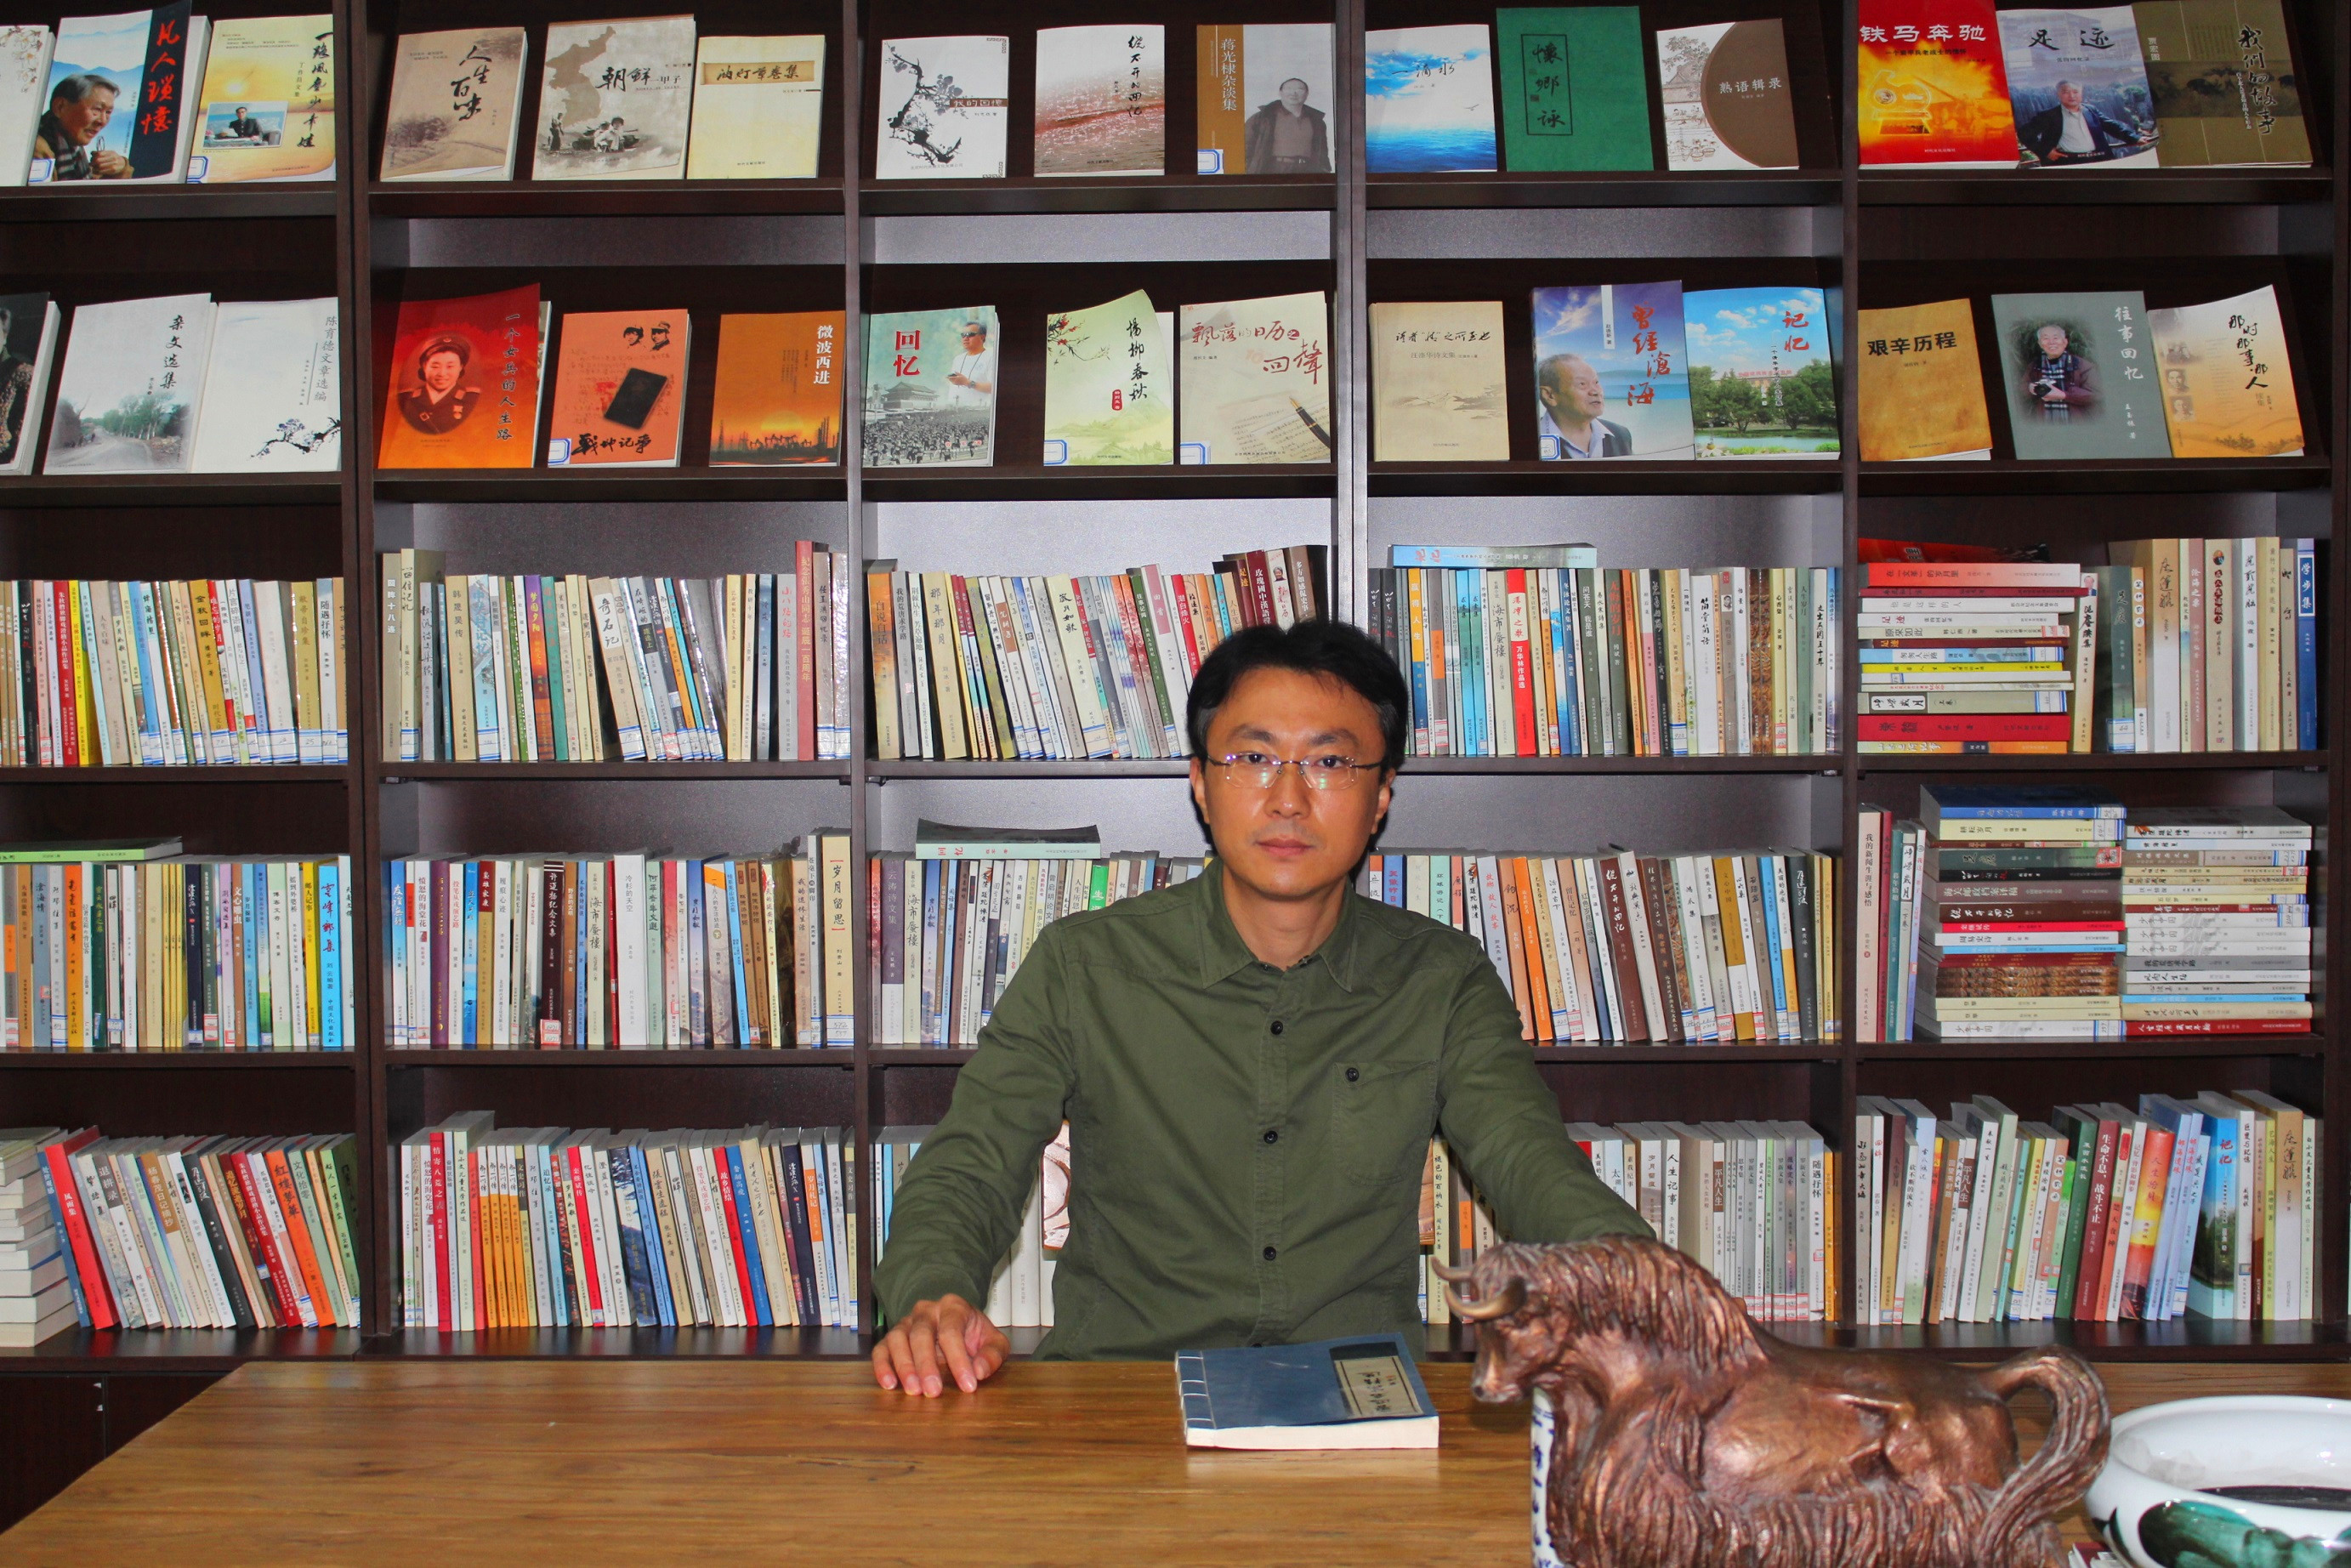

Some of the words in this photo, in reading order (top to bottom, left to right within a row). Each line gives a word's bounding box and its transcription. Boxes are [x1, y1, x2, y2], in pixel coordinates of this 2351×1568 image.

[1860, 24, 1987, 43] 铁马奔驰
[1718, 76, 1783, 95] 熟语辑录
[1783, 310, 1810, 352] 记忆
[1868, 331, 1958, 357] 艰辛历程
[814, 325, 834, 385] 微波西进
[893, 329, 922, 378] 回忆
[2299, 562, 2312, 610] 学步集
[876, 599, 889, 645] 自说自话
[938, 847, 963, 856] 回忆
[832, 864, 845, 926] 岁月留思
[2219, 1139, 2234, 1165] 记忆
[1667, 1153, 1679, 1206] 人生记事
[1714, 1168, 1724, 1207] 平凡人生
[1958, 1165, 1973, 1203] 平凡人生
